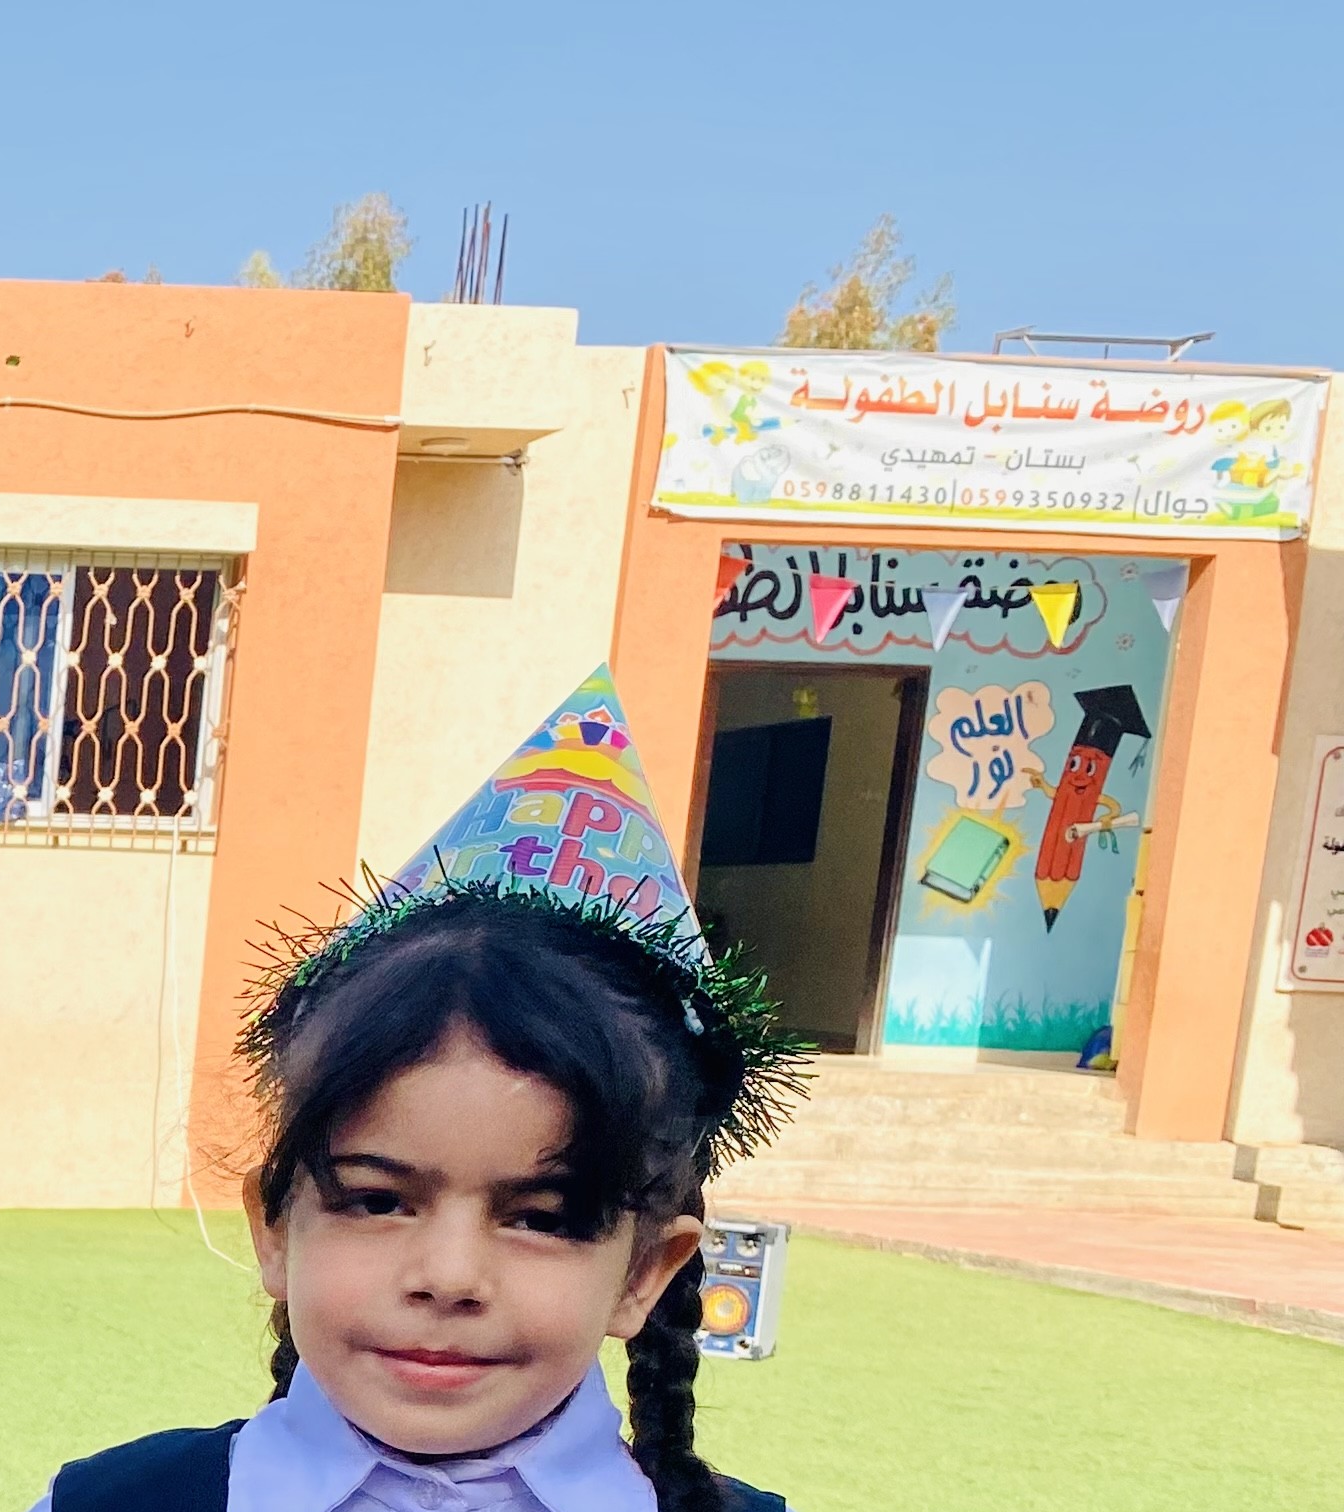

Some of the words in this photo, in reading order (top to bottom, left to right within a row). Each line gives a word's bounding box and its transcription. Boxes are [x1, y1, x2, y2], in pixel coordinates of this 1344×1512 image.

[789, 367, 956, 423] الطفولة
[964, 380, 1081, 433] سنابل
[1090, 380, 1207, 435] روضة
[881, 446, 976, 472] تمهيدي
[1005, 447, 1086, 475] بستان
[951, 694, 1029, 757] العلم
[968, 745, 1013, 800] نور
